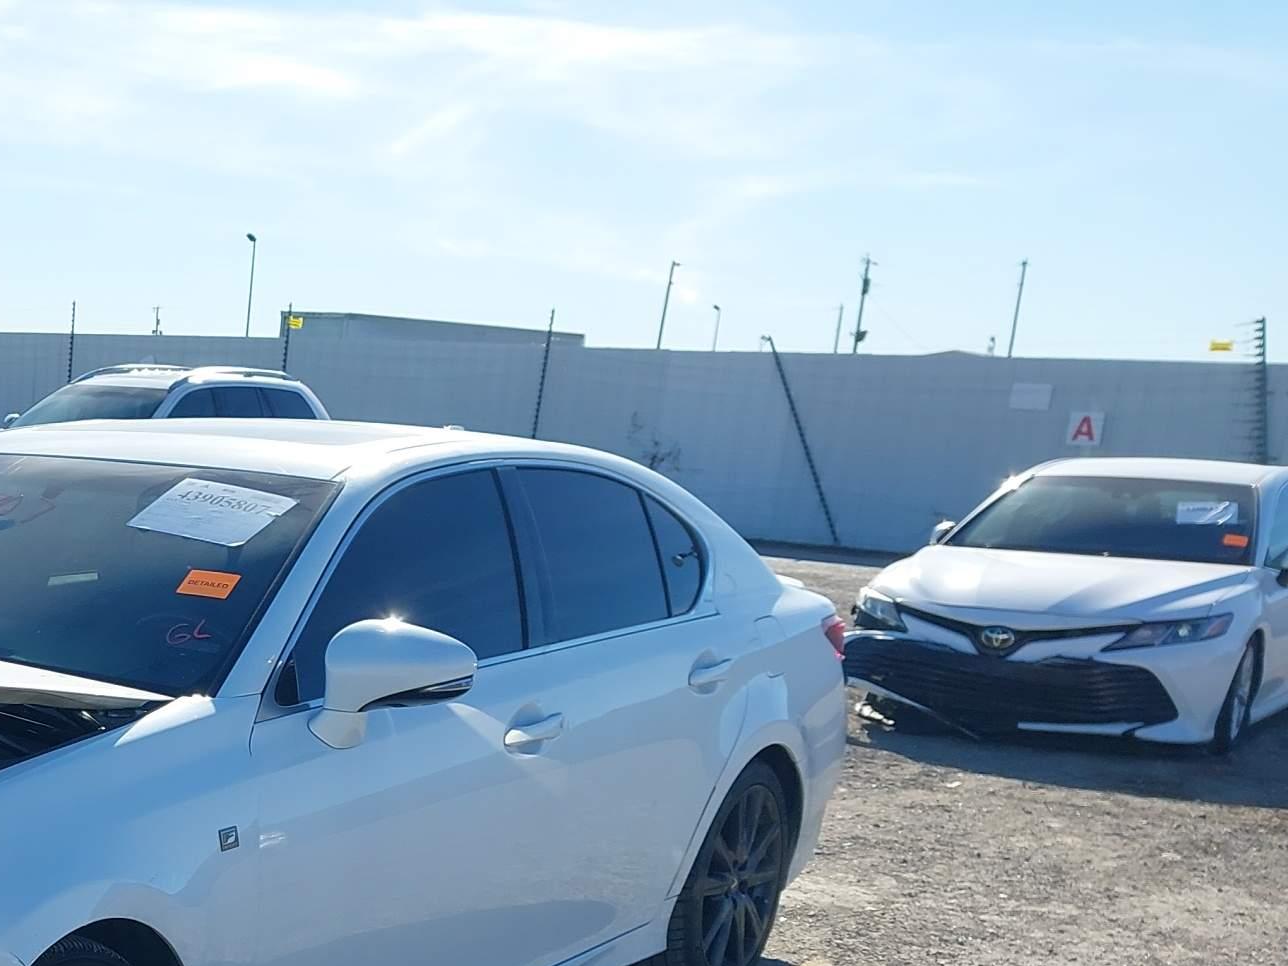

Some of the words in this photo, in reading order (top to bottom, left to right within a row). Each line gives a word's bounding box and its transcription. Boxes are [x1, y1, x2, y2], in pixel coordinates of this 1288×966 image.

[1072, 415, 1095, 442] A
[177, 490, 272, 515] 43905807
[188, 579, 229, 590] DETAILED
